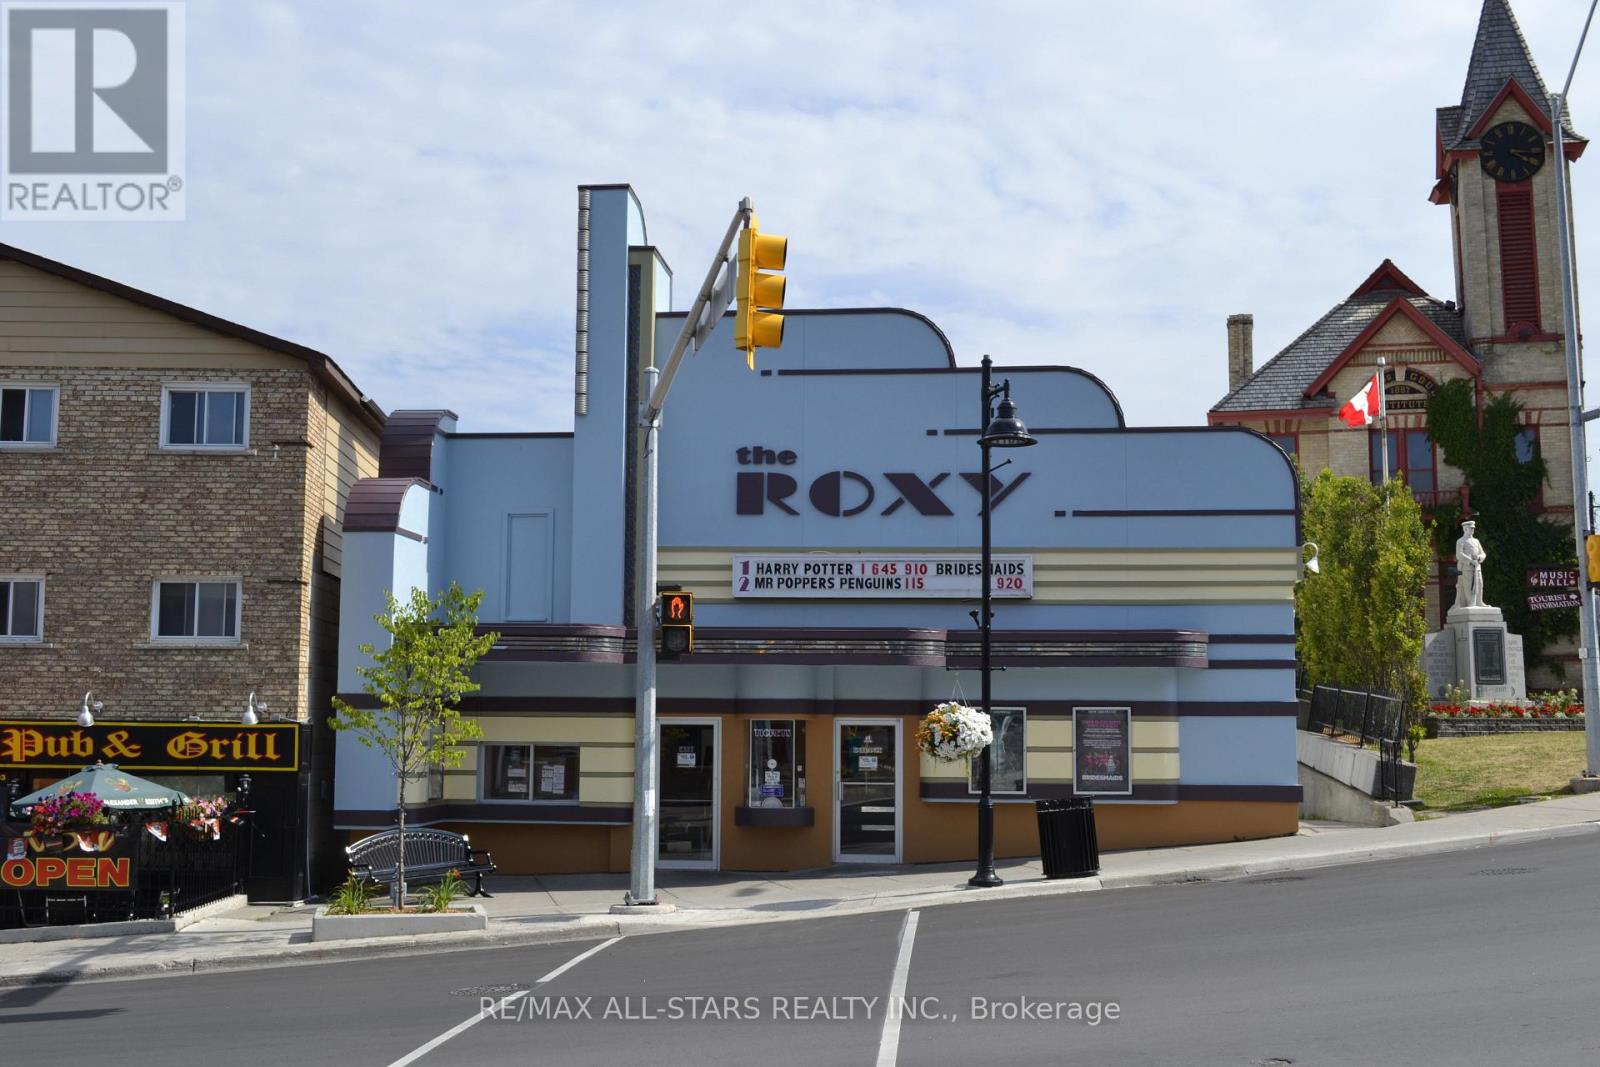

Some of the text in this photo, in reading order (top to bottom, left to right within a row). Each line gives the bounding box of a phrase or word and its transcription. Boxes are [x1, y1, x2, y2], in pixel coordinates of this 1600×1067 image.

[736, 446, 797, 465] the
[736, 471, 1032, 516] ROXY
[756, 563, 799, 575] HARRY
[804, 563, 853, 575] POTTER
[872, 563, 897, 575] 645
[904, 563, 928, 575] 910
[936, 563, 1024, 575] BRIDESAIDS
[1539, 571, 1576, 579] MUSIC
[754, 578, 773, 589] MR
[777, 577, 835, 589] POPPERS
[840, 577, 901, 589] PENGUINS
[996, 577, 1023, 589] 920
[1529, 594, 1567, 603] TOURIST
[1531, 600, 1580, 610] INFORMATION
[1, 728, 281, 762] Pub & Grill
[1, 857, 130, 887] OPEN
